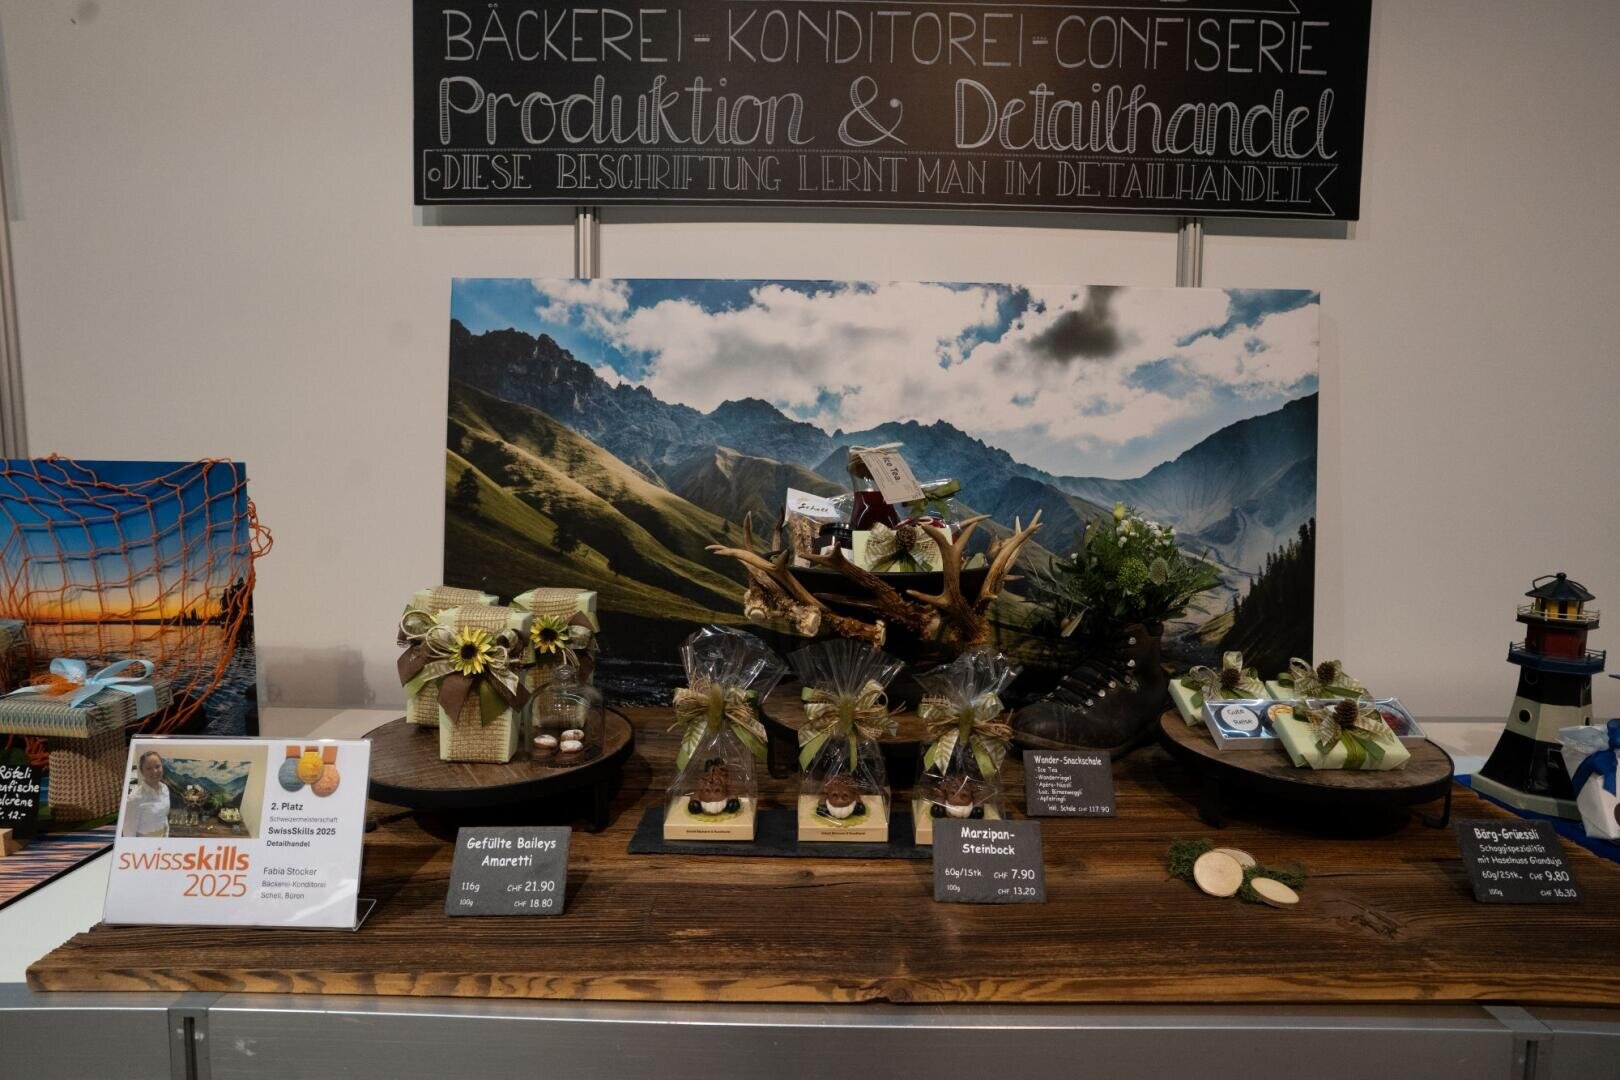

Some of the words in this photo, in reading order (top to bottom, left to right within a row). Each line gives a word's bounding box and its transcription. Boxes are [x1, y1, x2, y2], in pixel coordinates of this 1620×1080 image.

[440, 75, 815, 145] Produktion
[838, 76, 907, 146] &
[955, 78, 1338, 159] Detailhandel
[442, 154, 531, 190] DIESE
[556, 154, 781, 190] BESCHRIFTUNG
[798, 155, 907, 192] LERNT
[918, 158, 986, 195] MAN
[1004, 161, 1041, 196] IM
[1056, 161, 1311, 202] DETAILHANDEL
[1034, 755, 1102, 766] Wander-Snackschale
[271, 802, 279, 811] 2.
[281, 802, 304, 811] Platz
[1089, 805, 1110, 813] 117.90
[268, 826, 314, 836] SwissSkills
[316, 827, 336, 836] 2025
[961, 826, 1015, 843] Marzipan-
[1473, 827, 1540, 842] Bärg-Grüessli
[266, 840, 310, 848] Detailhandel
[467, 837, 512, 850] Gefüllte
[517, 836, 557, 852] Baileys
[962, 843, 1016, 855] Steinbock
[118, 846, 250, 871] swissskills
[481, 854, 533, 867] Amaretti
[1477, 855, 1490, 864] mit
[1491, 856, 1529, 865] Haselnuss
[1529, 856, 1562, 867] Gianduja
[263, 866, 285, 875] Fabia
[287, 867, 317, 876] Stocker
[1011, 868, 1035, 880] 7.90
[1529, 872, 1543, 880] CHF
[1545, 870, 1570, 882] 9.80
[183, 873, 247, 898] 2025
[462, 882, 480, 893] 116g
[507, 884, 522, 892] CHF
[524, 880, 555, 892] 21.90
[947, 884, 961, 892] 100g
[1013, 886, 1036, 896] 13.20
[1554, 888, 1577, 898] 16.30
[459, 899, 474, 907] 100g
[529, 898, 553, 908] 18.80
